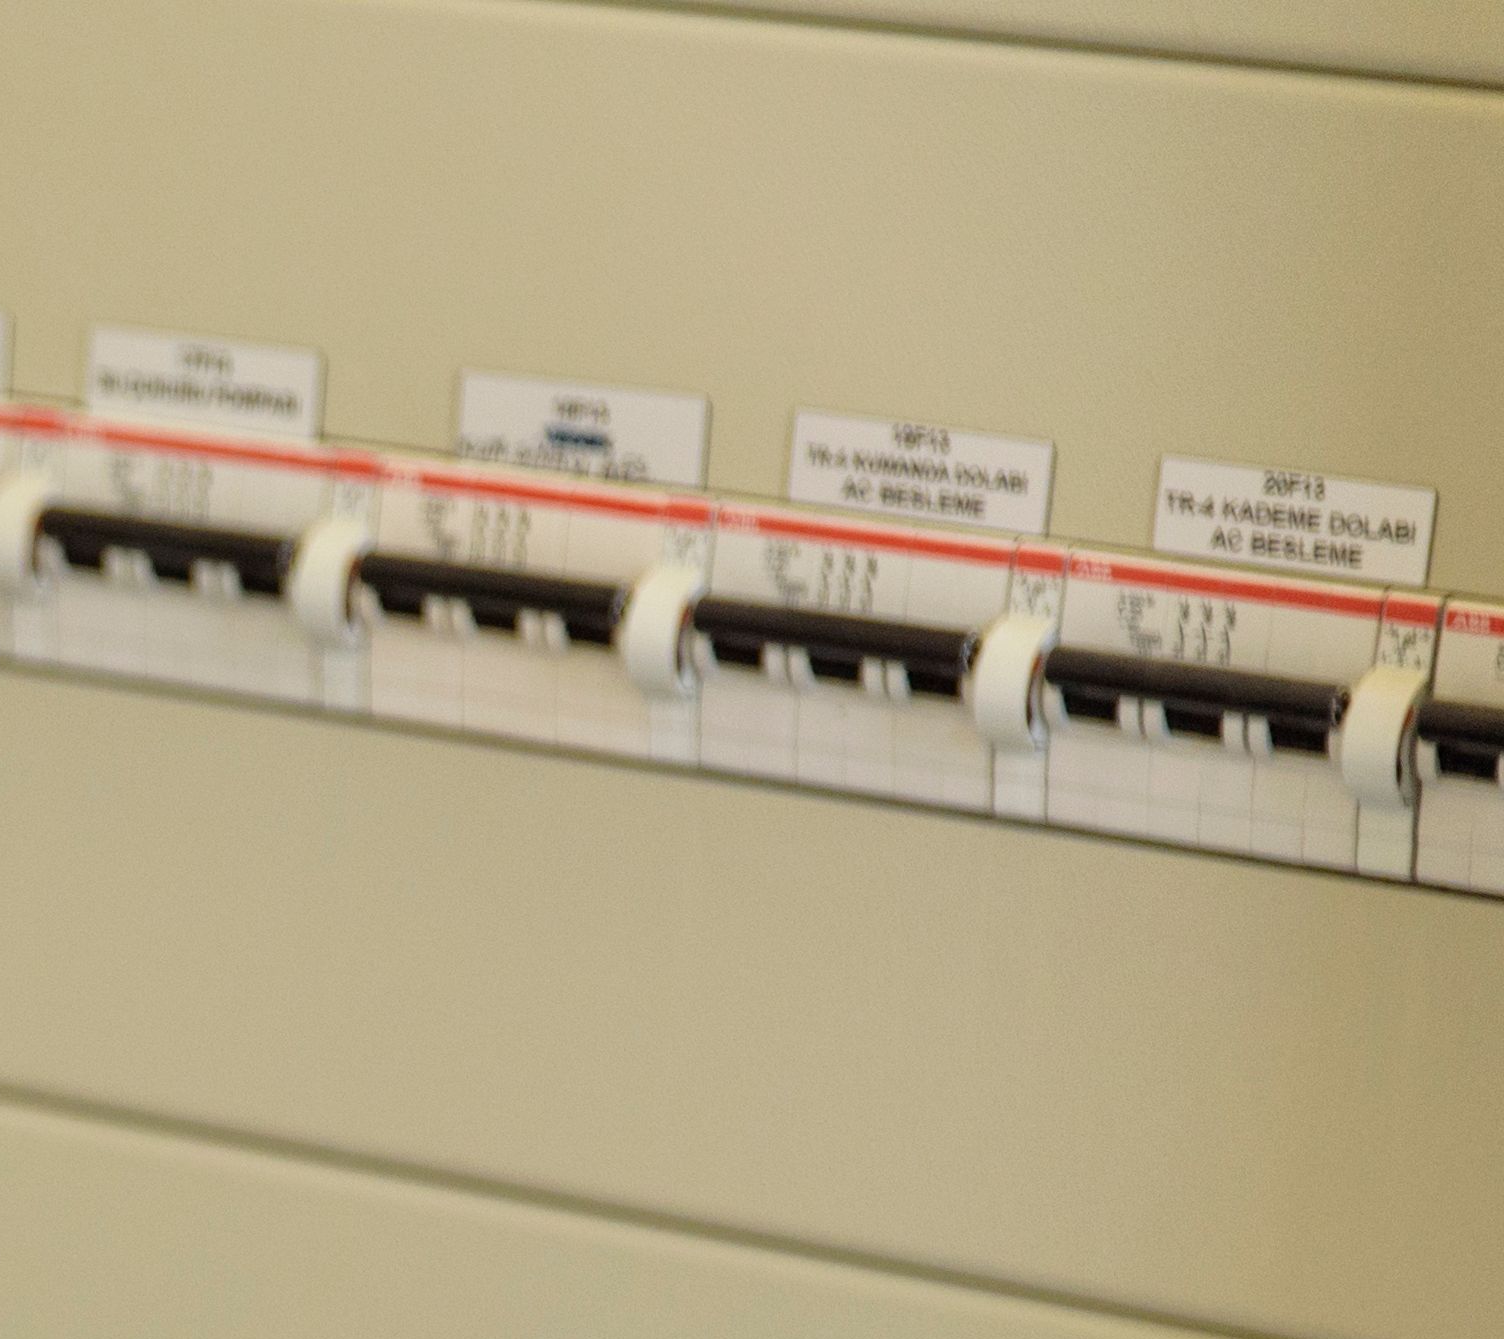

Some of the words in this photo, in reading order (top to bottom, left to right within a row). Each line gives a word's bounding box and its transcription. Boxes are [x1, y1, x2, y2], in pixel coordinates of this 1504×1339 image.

[879, 480, 986, 519] BESLEME
[1221, 495, 1321, 533] KADEME
[1329, 512, 1417, 546] DOLABI
[1210, 525, 1244, 552] AC
[1249, 529, 1364, 570] BESLEME
